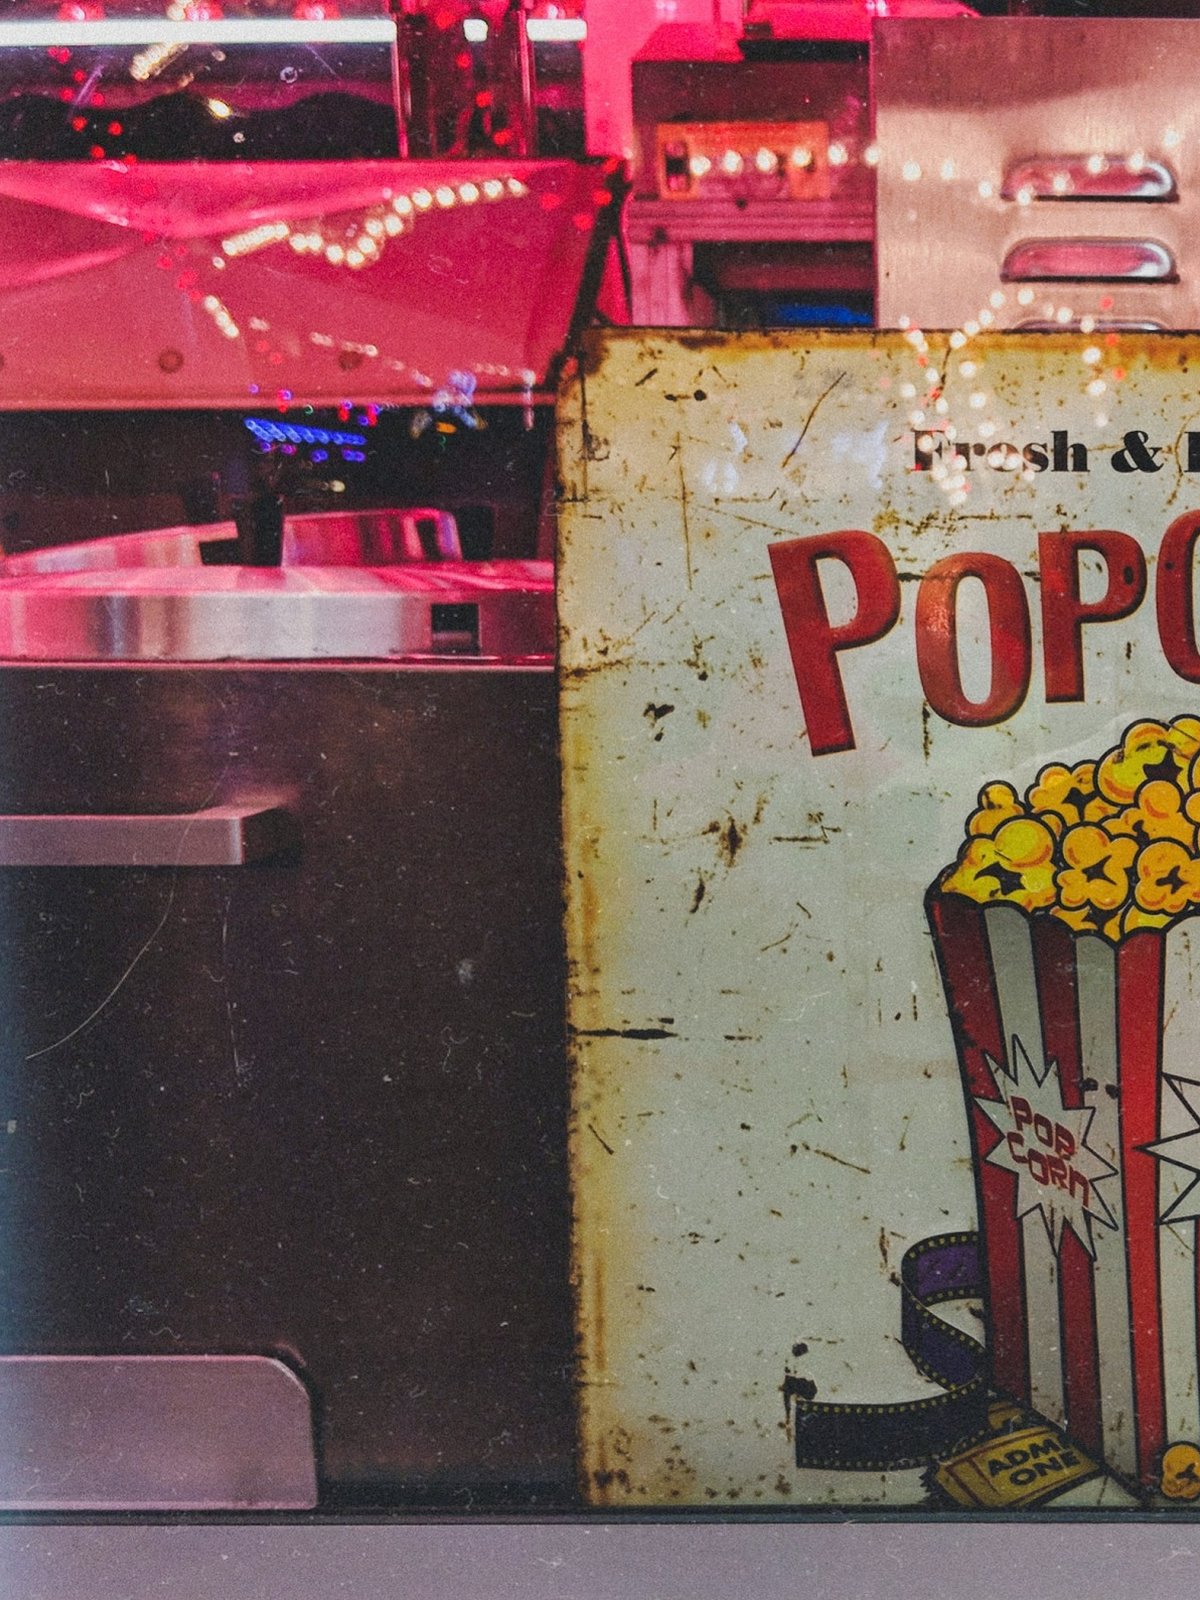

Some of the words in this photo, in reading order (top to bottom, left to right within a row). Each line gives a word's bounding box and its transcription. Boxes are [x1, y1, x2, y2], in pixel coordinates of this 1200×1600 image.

[910, 429, 1090, 474] Fresh
[1110, 429, 1166, 474] &
[1009, 1095, 1078, 1162] POP
[1009, 1449, 1081, 1487] ONE
